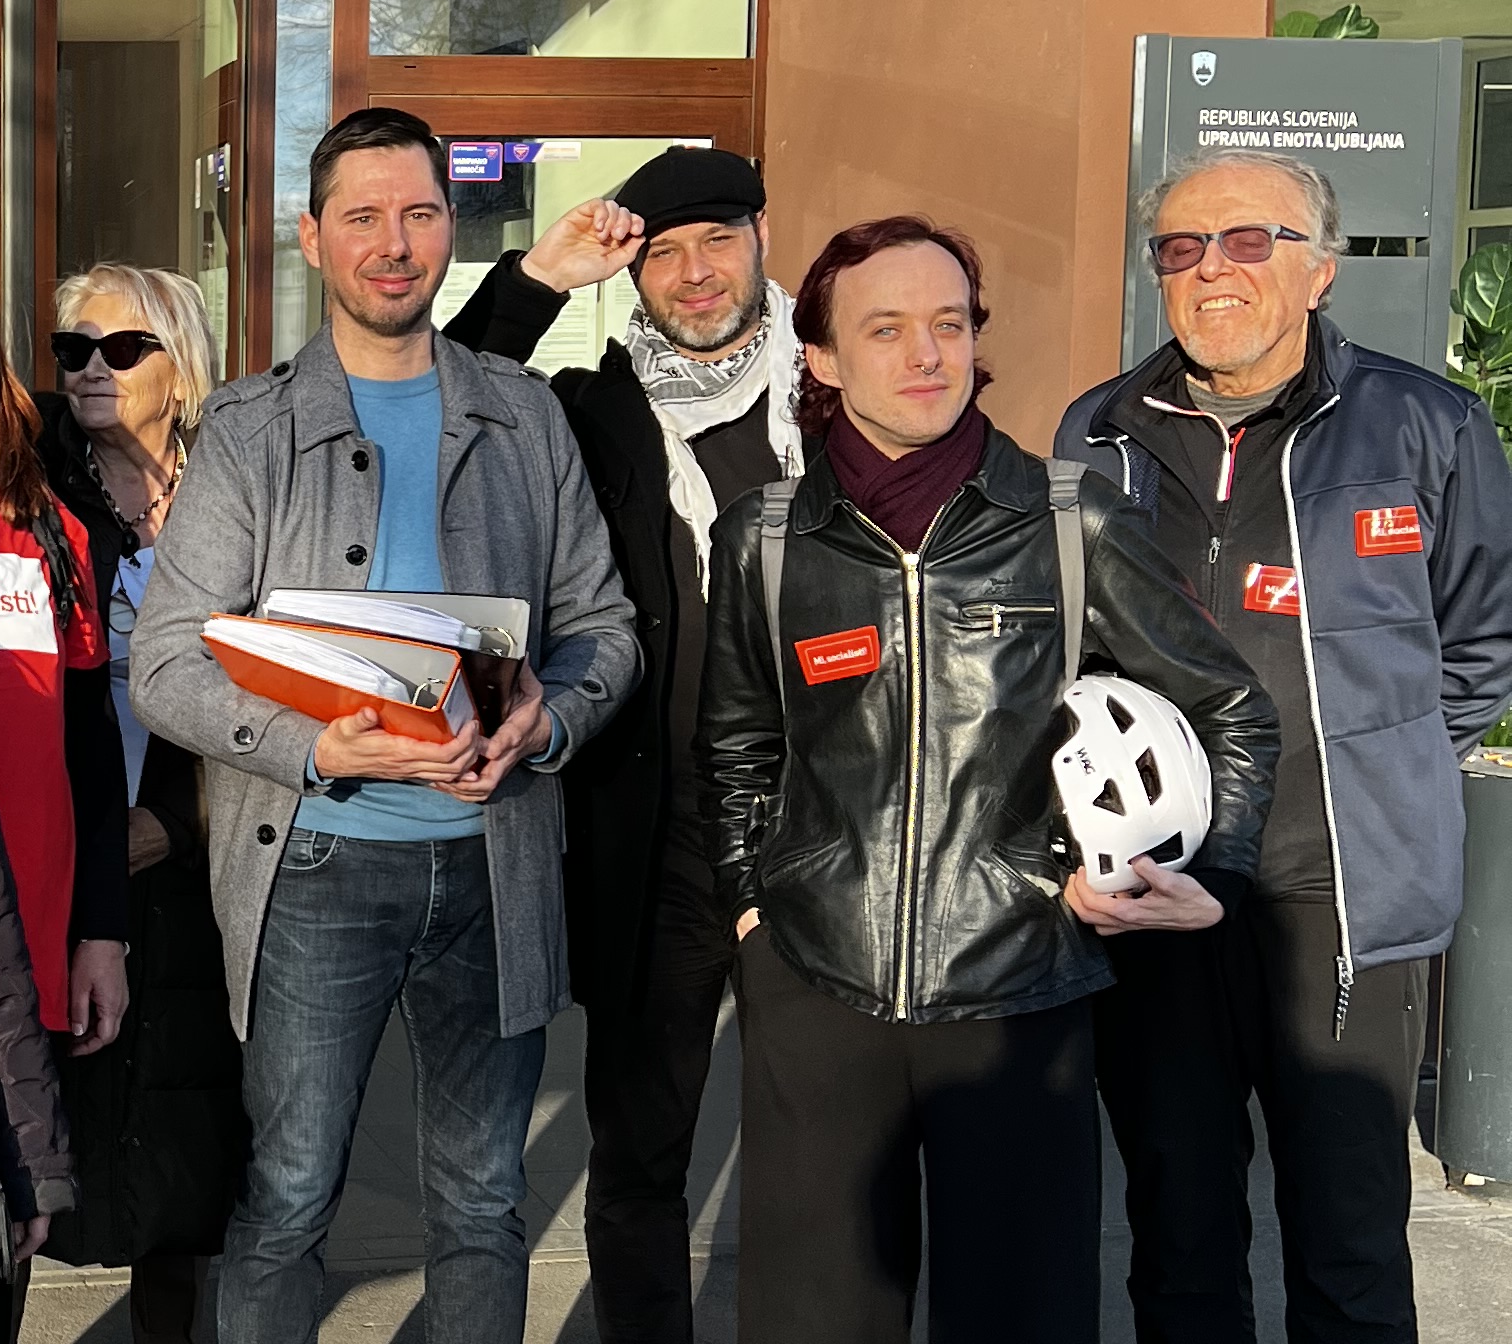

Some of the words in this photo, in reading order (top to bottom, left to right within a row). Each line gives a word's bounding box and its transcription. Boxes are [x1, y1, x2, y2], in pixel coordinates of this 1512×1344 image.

[1199, 109, 1280, 126] REPUBLIKA
[1282, 111, 1358, 130] SLOVENIJA
[1199, 131, 1270, 147] UPRAVNA
[1273, 132, 1323, 148] ENOTA
[1326, 133, 1405, 151] LJUBLJANA
